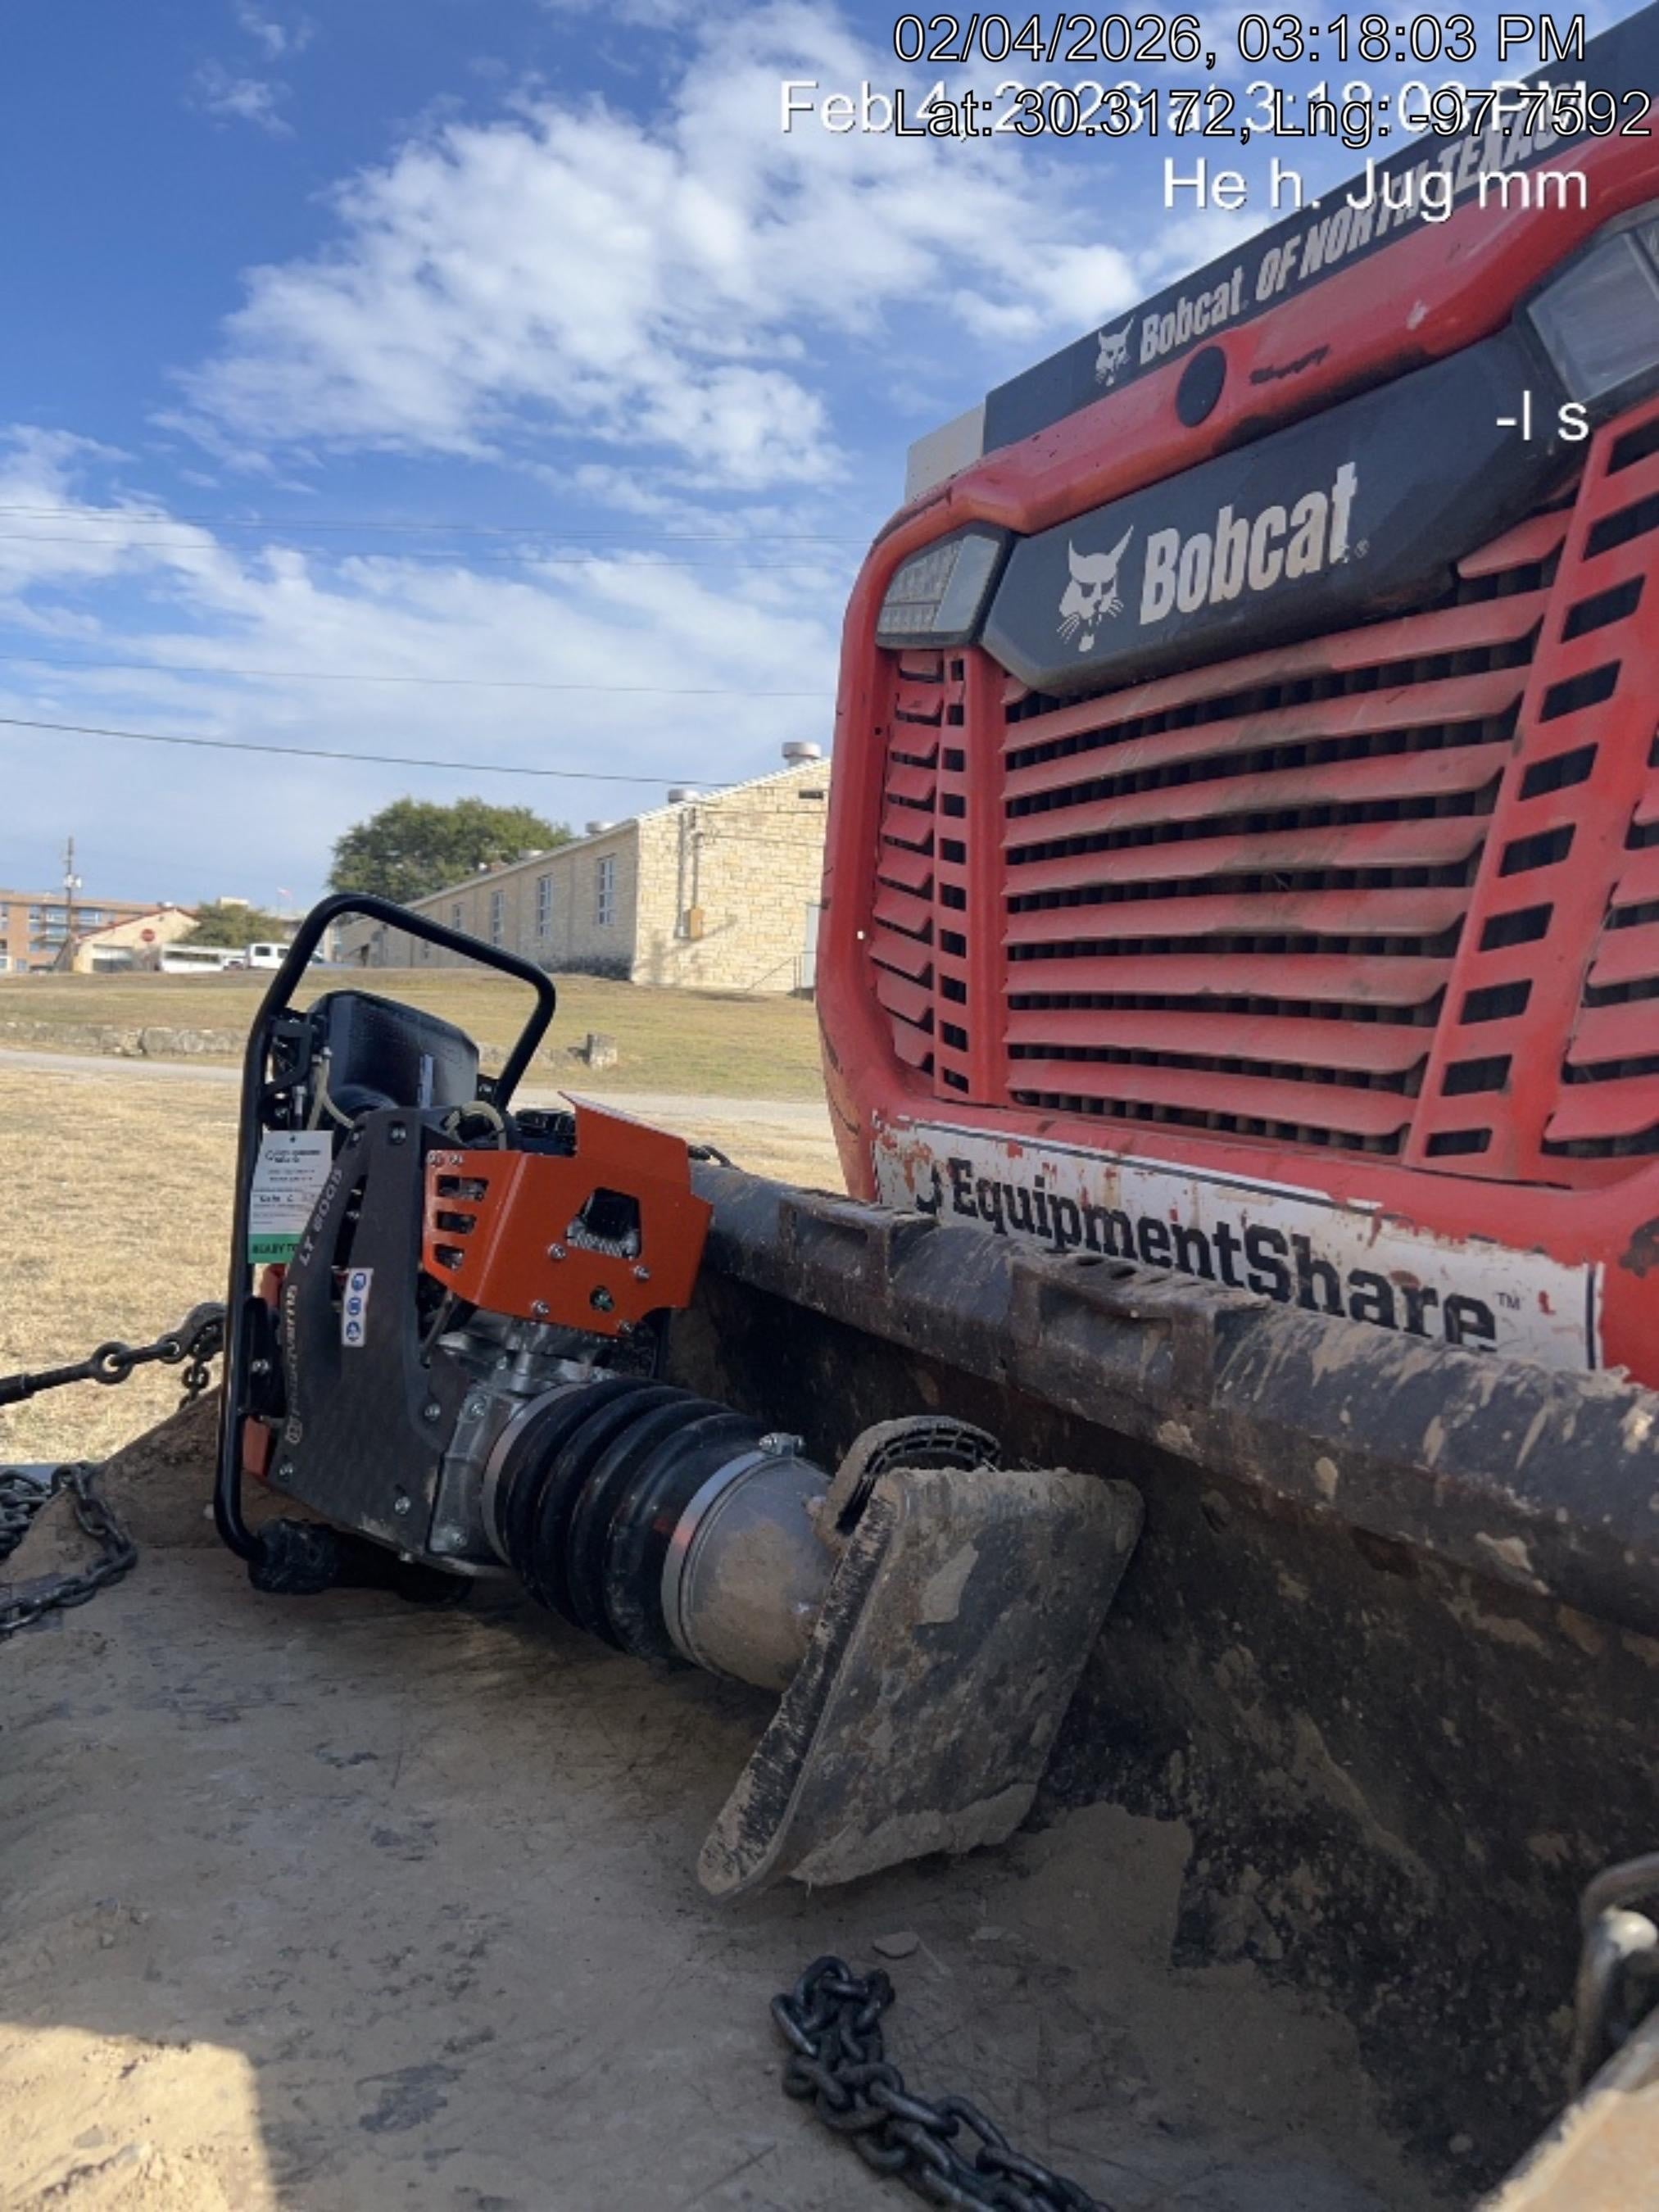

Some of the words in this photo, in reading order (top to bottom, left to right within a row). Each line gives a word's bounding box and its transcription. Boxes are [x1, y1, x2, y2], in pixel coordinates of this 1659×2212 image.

[1140, 266, 1243, 365] Bobcat
[1256, 240, 1299, 303] OF
[1140, 461, 1358, 625] Bobcat
[947, 1157, 1498, 1353] EquipmentShare
